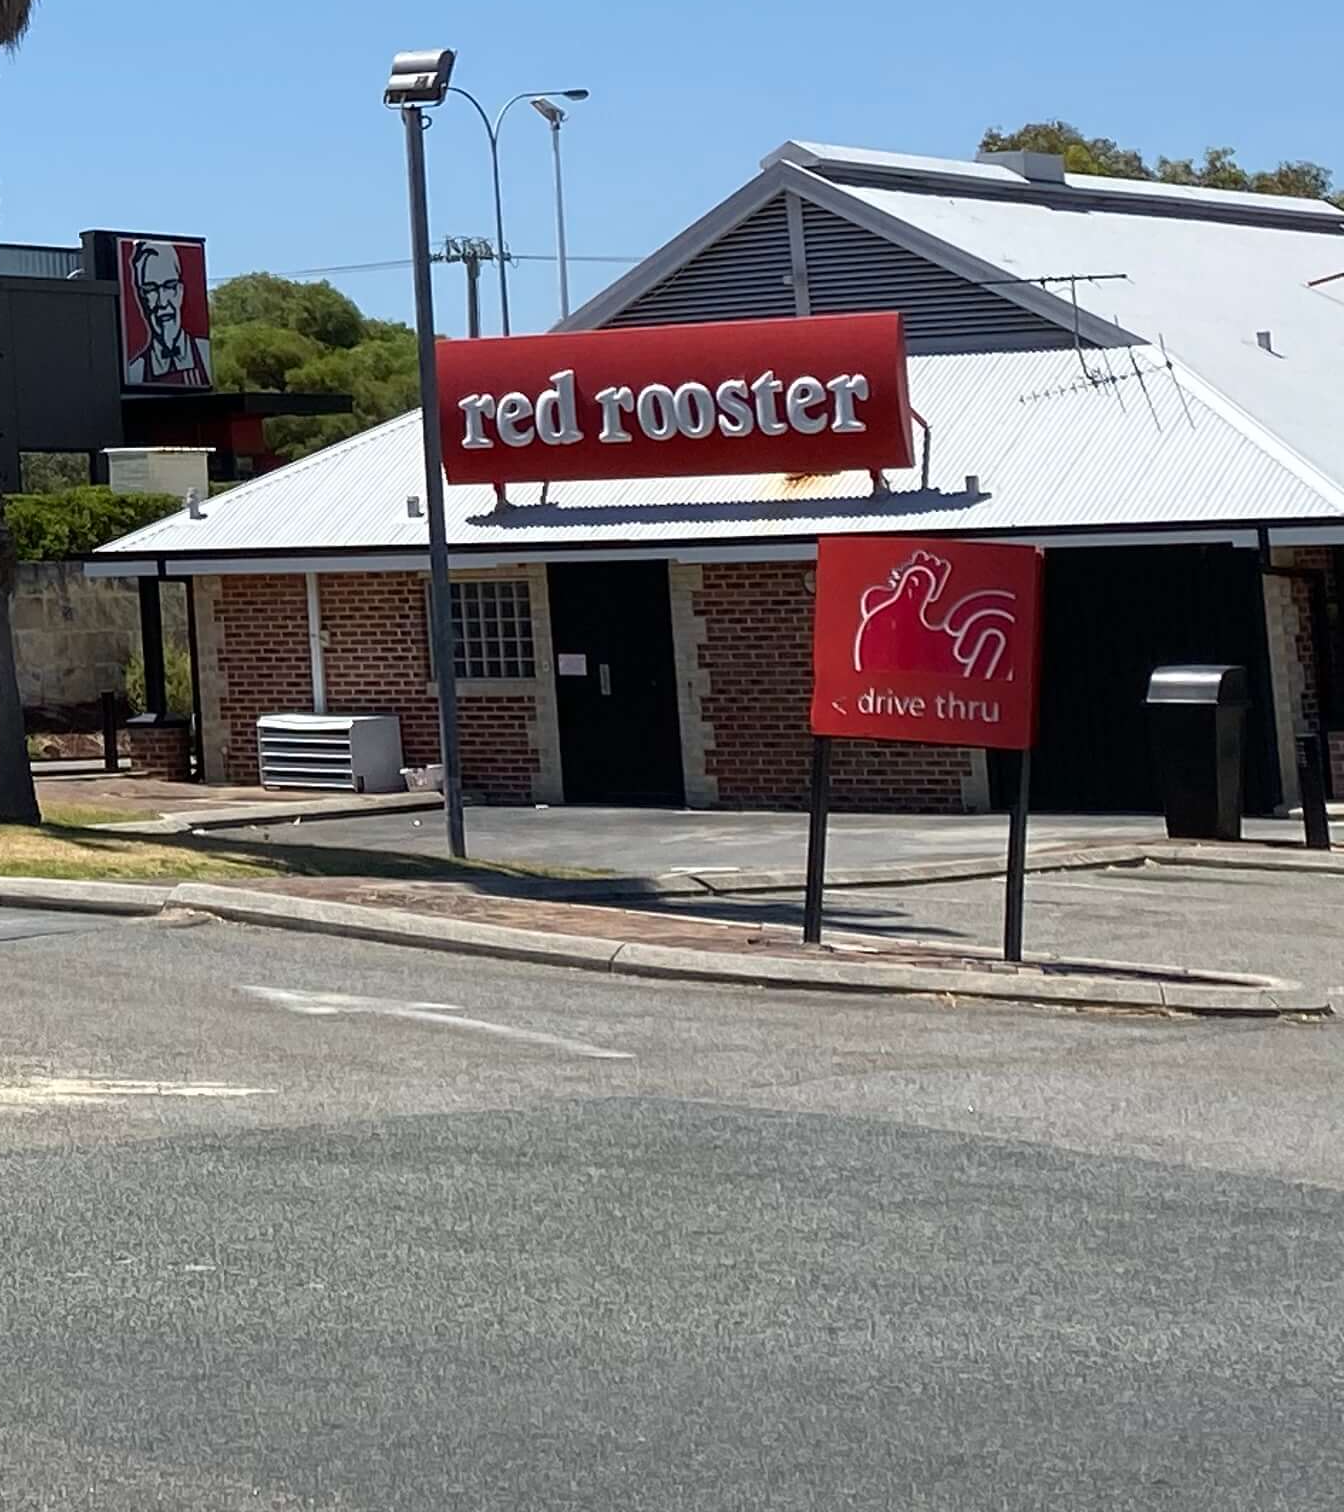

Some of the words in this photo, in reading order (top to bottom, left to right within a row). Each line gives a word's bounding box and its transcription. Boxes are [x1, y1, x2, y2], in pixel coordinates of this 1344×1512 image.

[457, 369, 584, 449] red
[594, 370, 869, 443] rooster
[857, 687, 926, 717] drive
[935, 691, 1000, 723] thru
